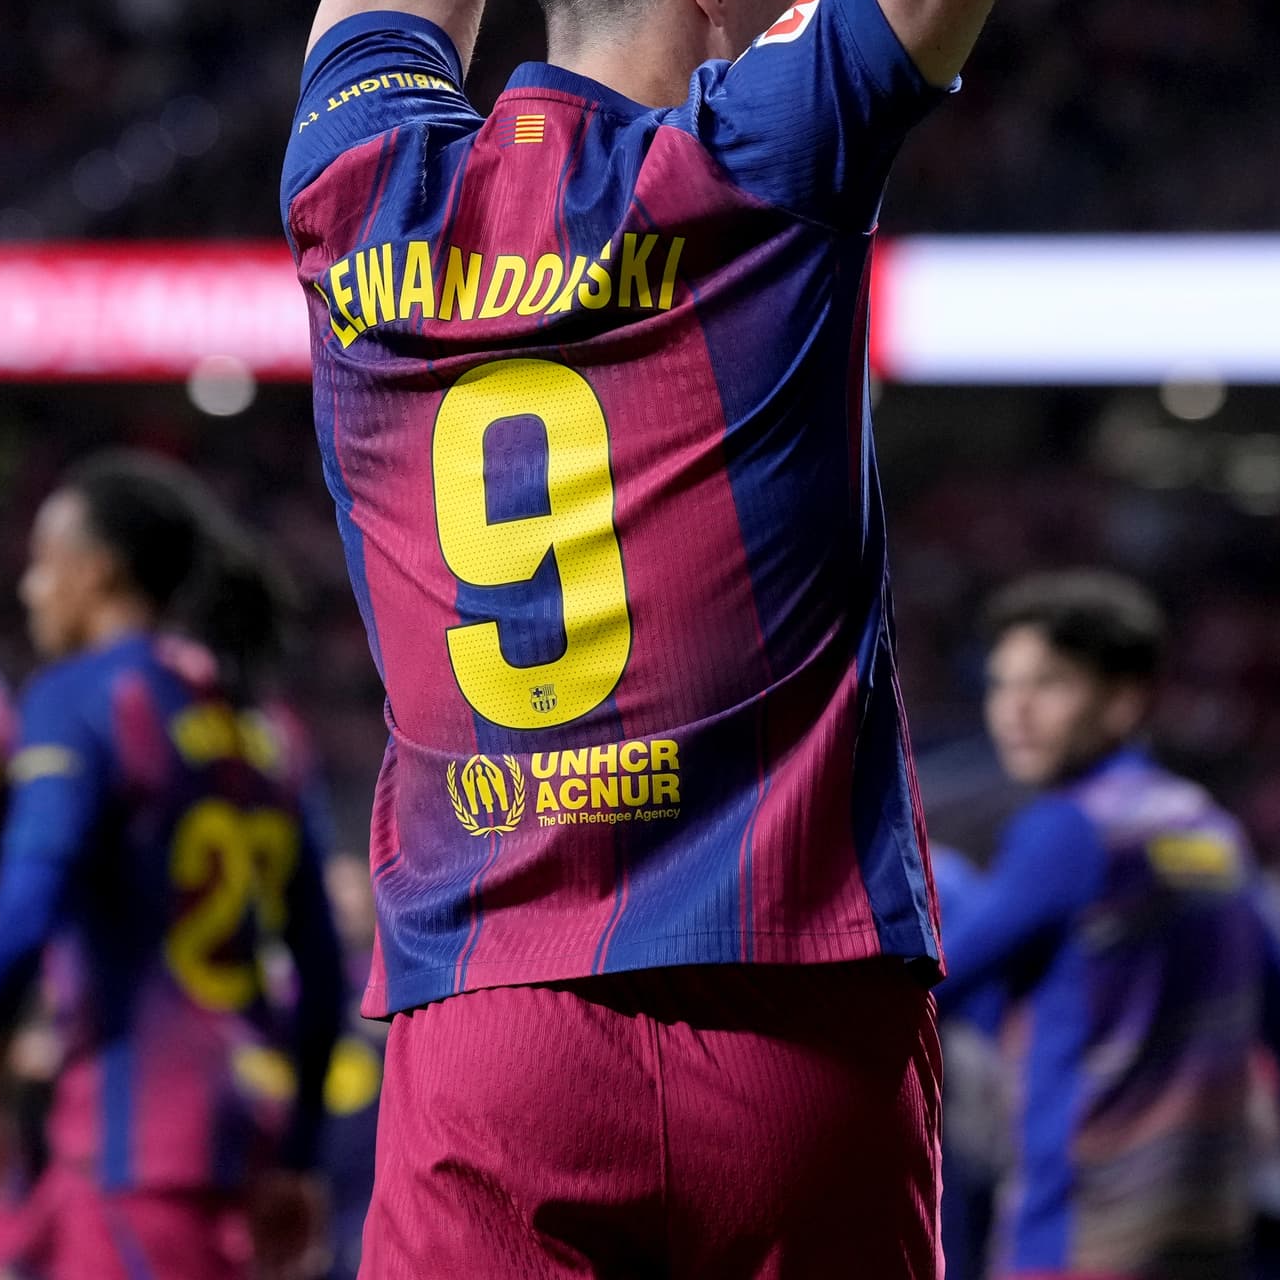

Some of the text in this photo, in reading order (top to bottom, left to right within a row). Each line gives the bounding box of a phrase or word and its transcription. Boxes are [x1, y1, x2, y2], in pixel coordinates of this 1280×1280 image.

[326, 72, 455, 112] MBILIGHT
[431, 357, 633, 731] 9
[531, 739, 680, 780] UNHCR
[535, 773, 681, 814] ACNUR
[538, 807, 681, 828] The UN Refugee Agency
